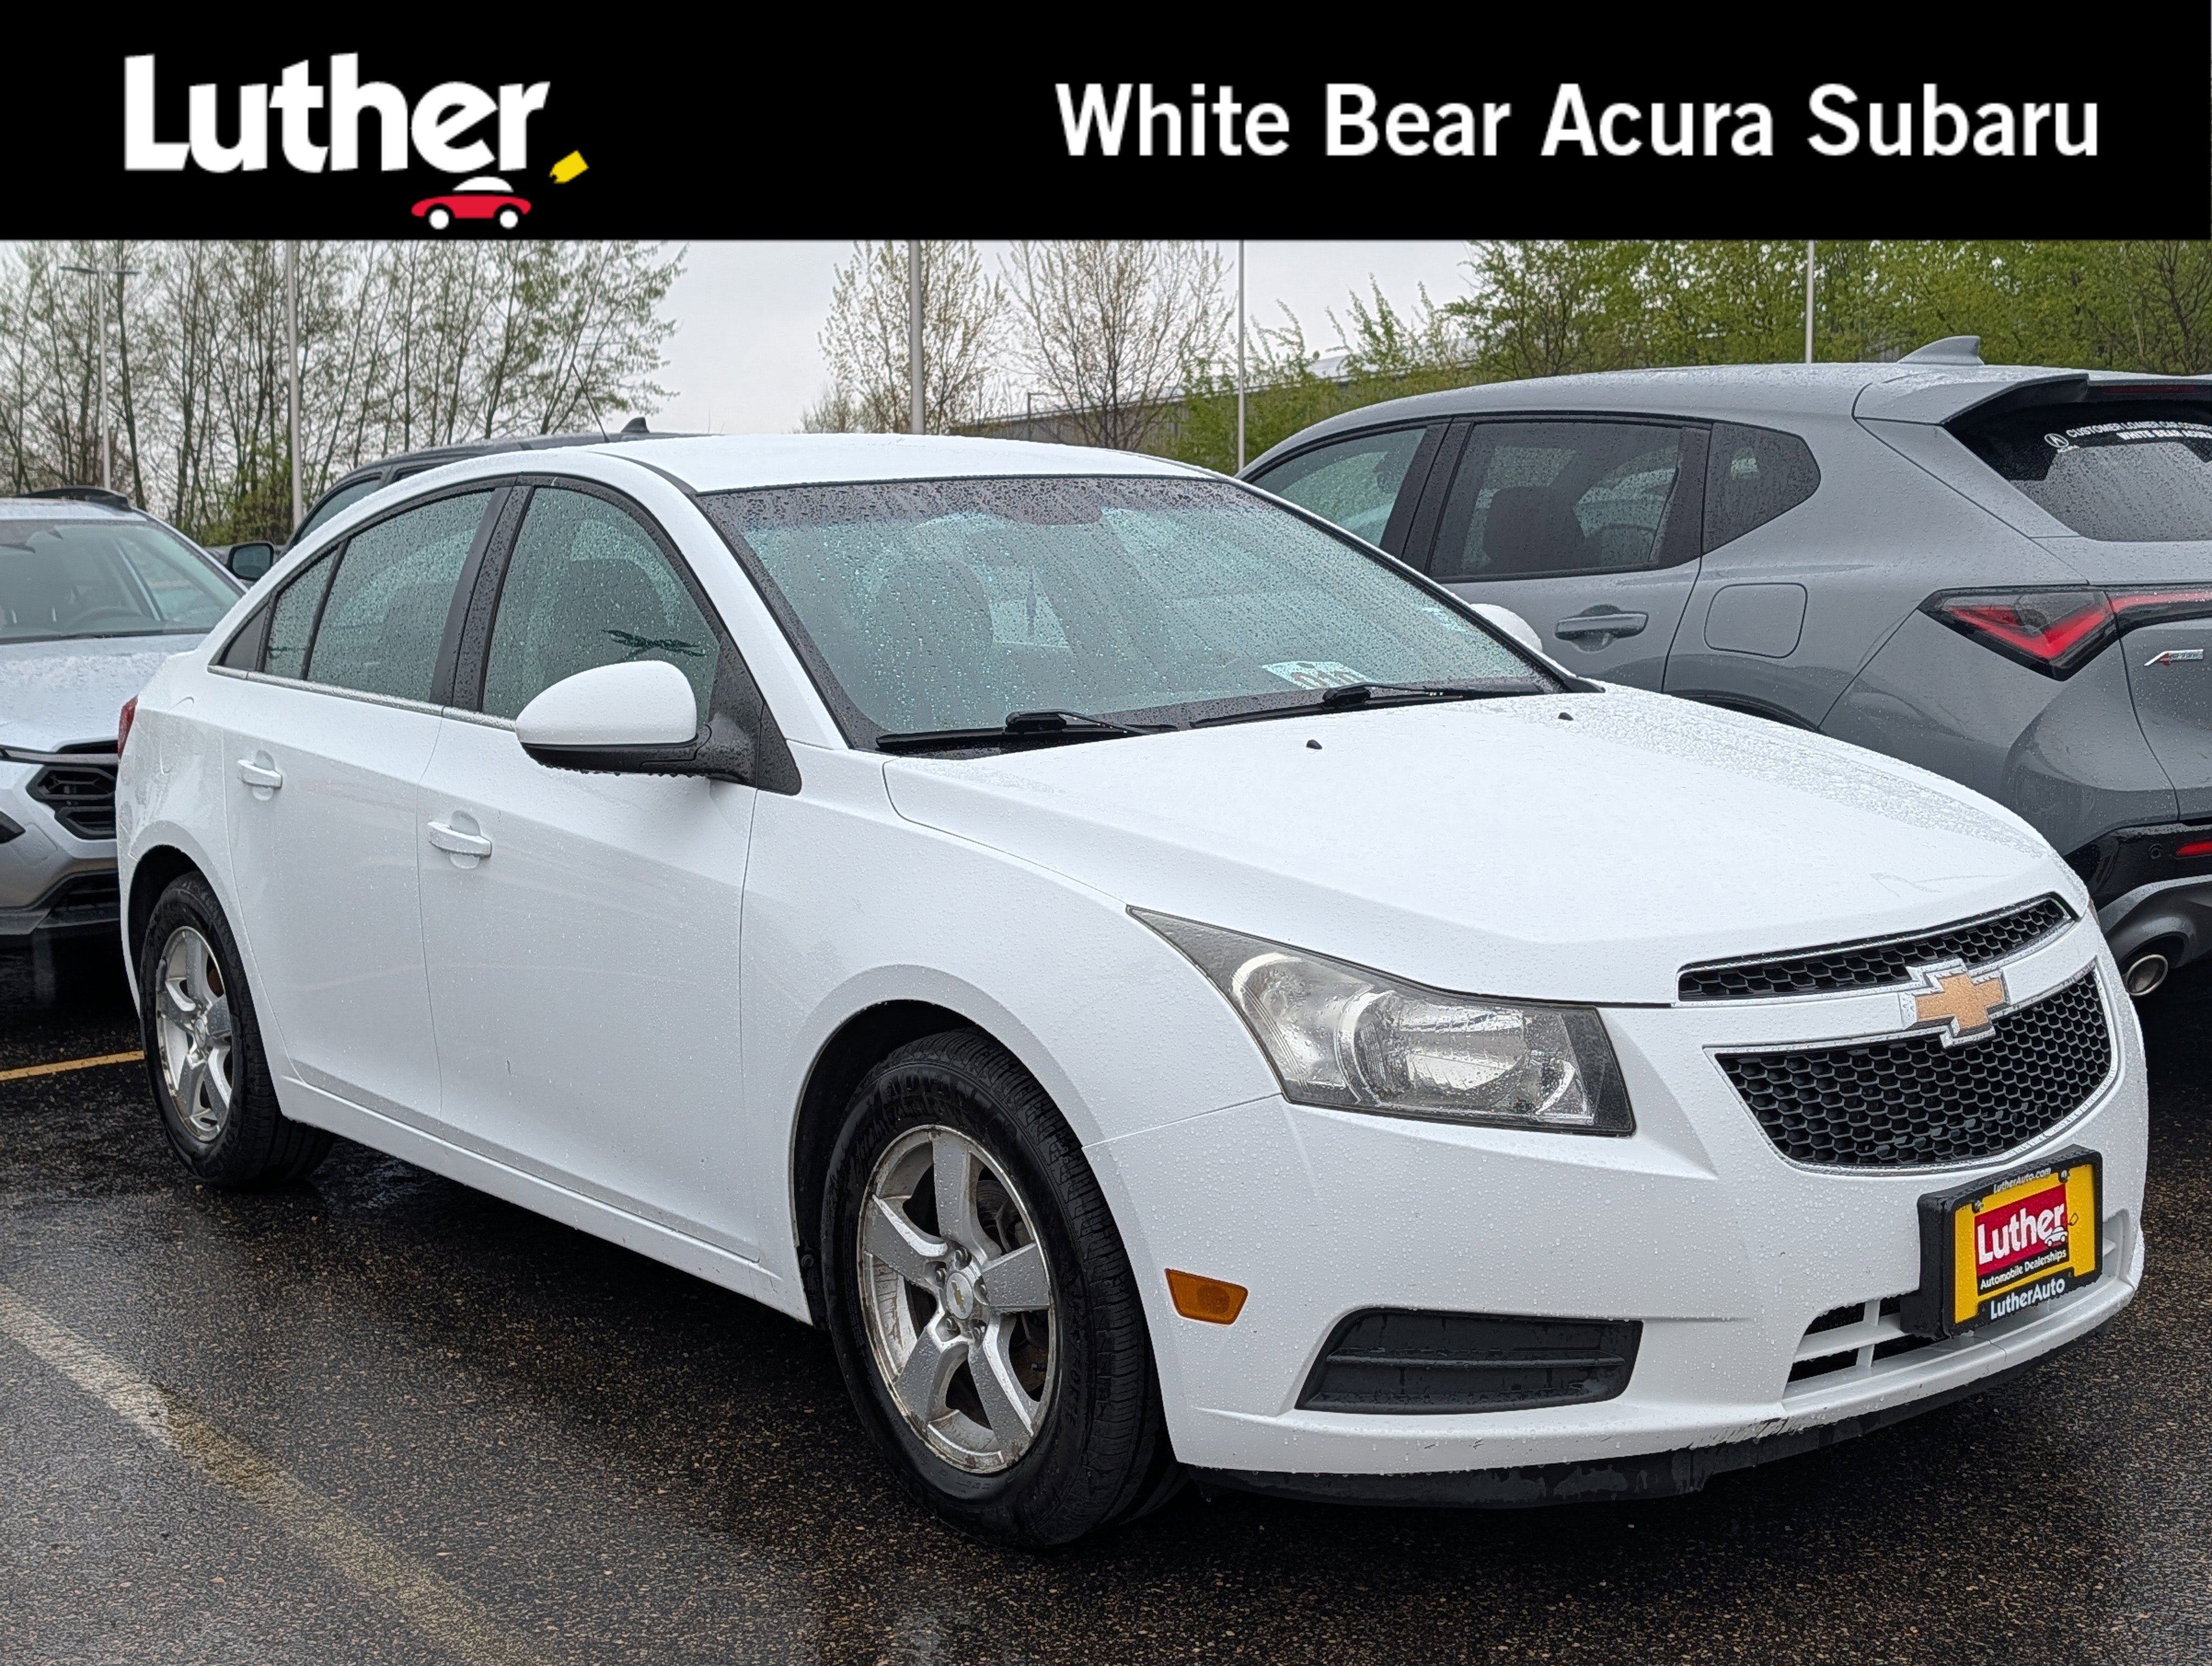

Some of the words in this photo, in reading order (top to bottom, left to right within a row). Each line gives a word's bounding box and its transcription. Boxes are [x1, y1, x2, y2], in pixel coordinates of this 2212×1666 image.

[2066, 422, 2124, 438] CUSTOMER
[2120, 421, 2162, 430] LOANER
[2116, 430, 2156, 440] WHITE
[1994, 1167, 2052, 1194] LutherAuto.com
[1977, 1203, 2065, 1265] Luther
[1980, 1265, 2023, 1290] Automobile
[2024, 1249, 2067, 1272] Dealerships
[1990, 1278, 2066, 1315] LutherAuto
